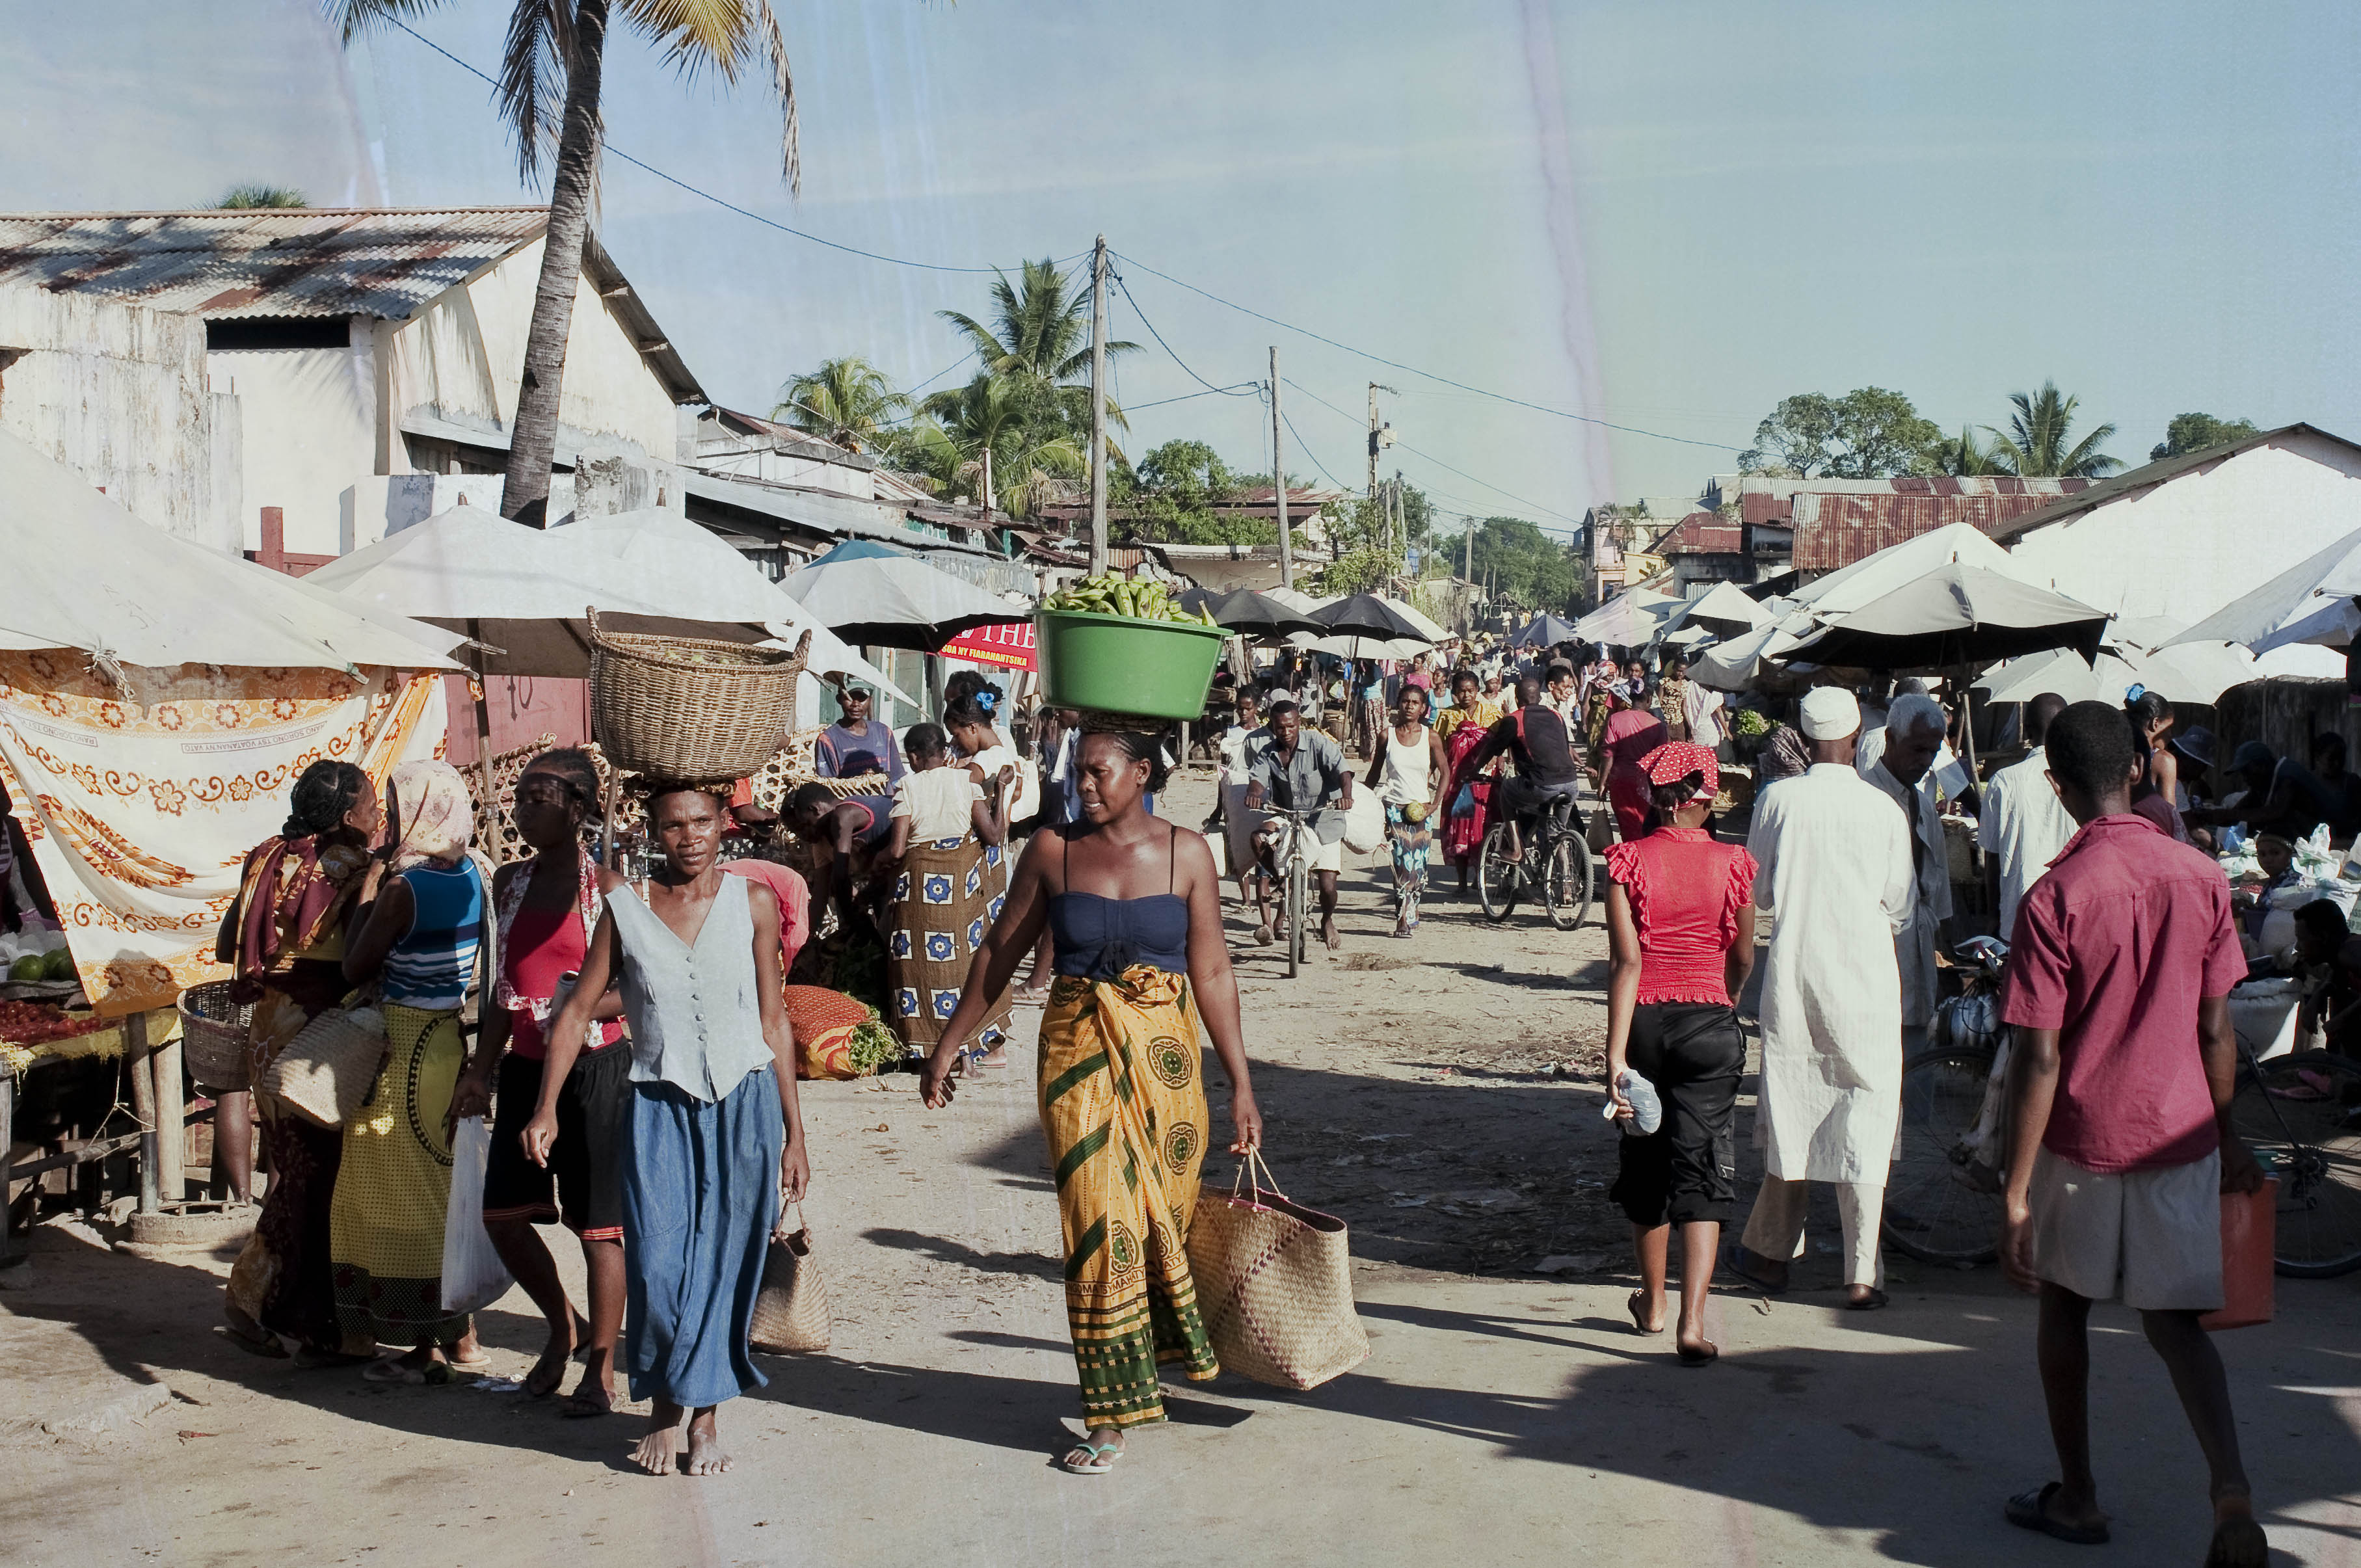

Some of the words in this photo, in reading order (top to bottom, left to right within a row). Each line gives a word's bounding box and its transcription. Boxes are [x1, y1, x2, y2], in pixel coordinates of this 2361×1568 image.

[941, 644, 957, 654] SOA
[958, 646, 968, 656] NY
[969, 648, 1028, 667] FIARAHANTSIKA
